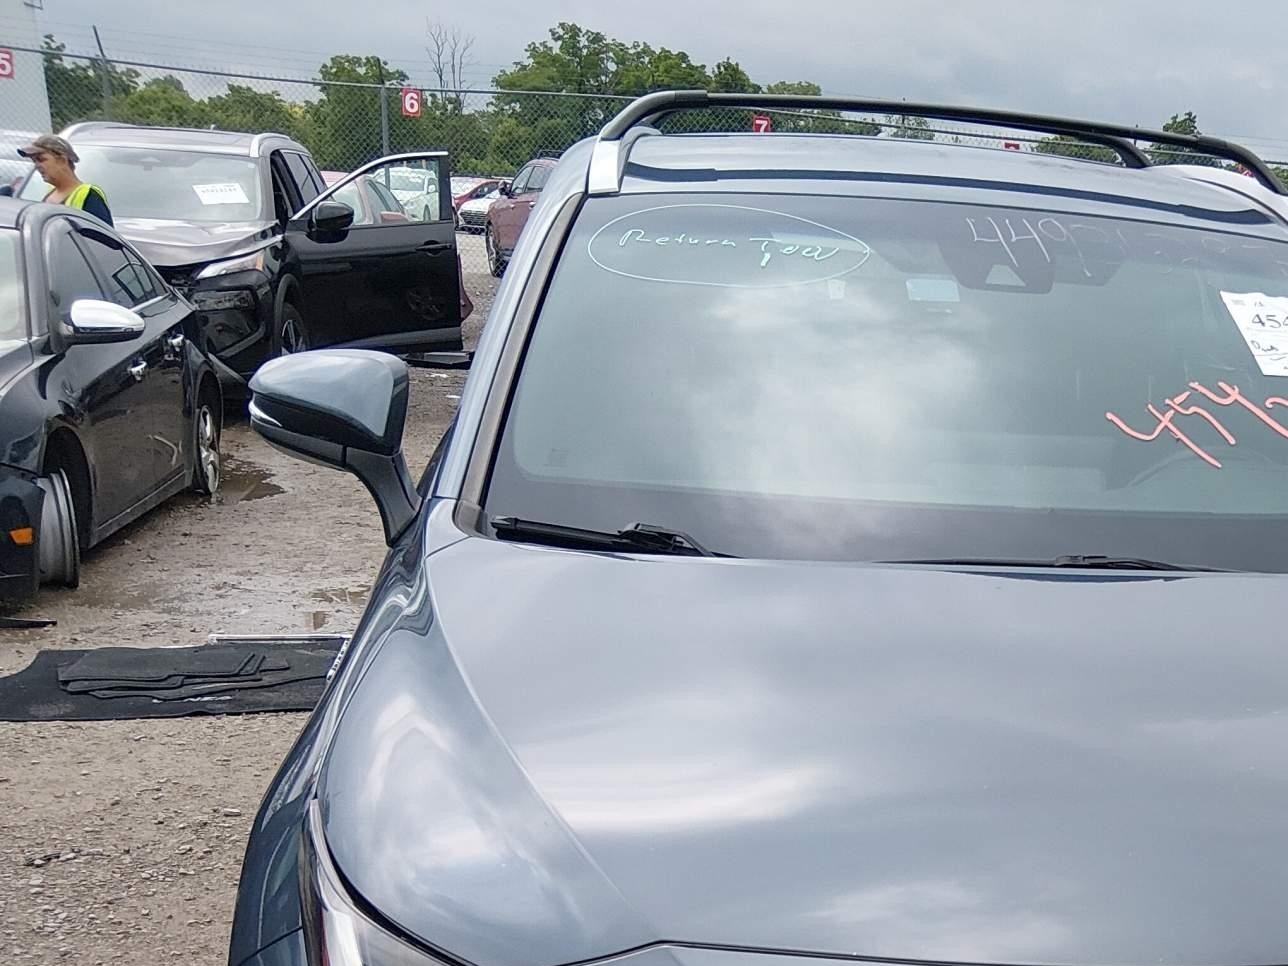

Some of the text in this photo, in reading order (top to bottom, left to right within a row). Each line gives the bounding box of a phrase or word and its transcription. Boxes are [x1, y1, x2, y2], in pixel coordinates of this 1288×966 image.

[0, 52, 12, 76] 5
[404, 91, 419, 114] 6
[755, 119, 768, 135] 7
[618, 229, 736, 248] Return
